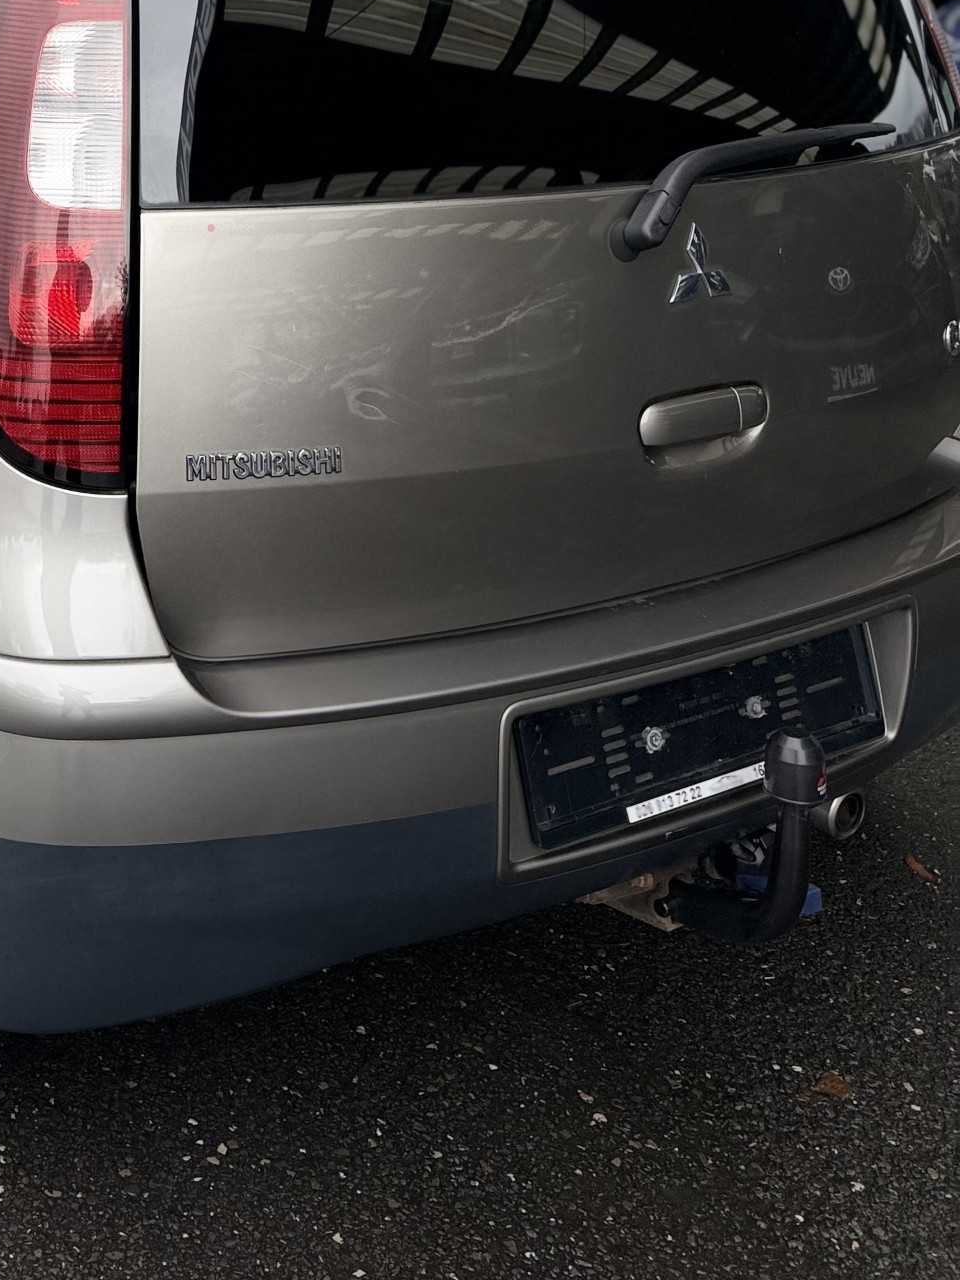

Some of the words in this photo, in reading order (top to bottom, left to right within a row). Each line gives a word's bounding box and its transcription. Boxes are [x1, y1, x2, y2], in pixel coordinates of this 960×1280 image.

[185, 446, 343, 482] MITSUBISHI
[675, 790, 689, 805] 72
[689, 785, 703, 800] 22
[753, 763, 765, 779] 16
